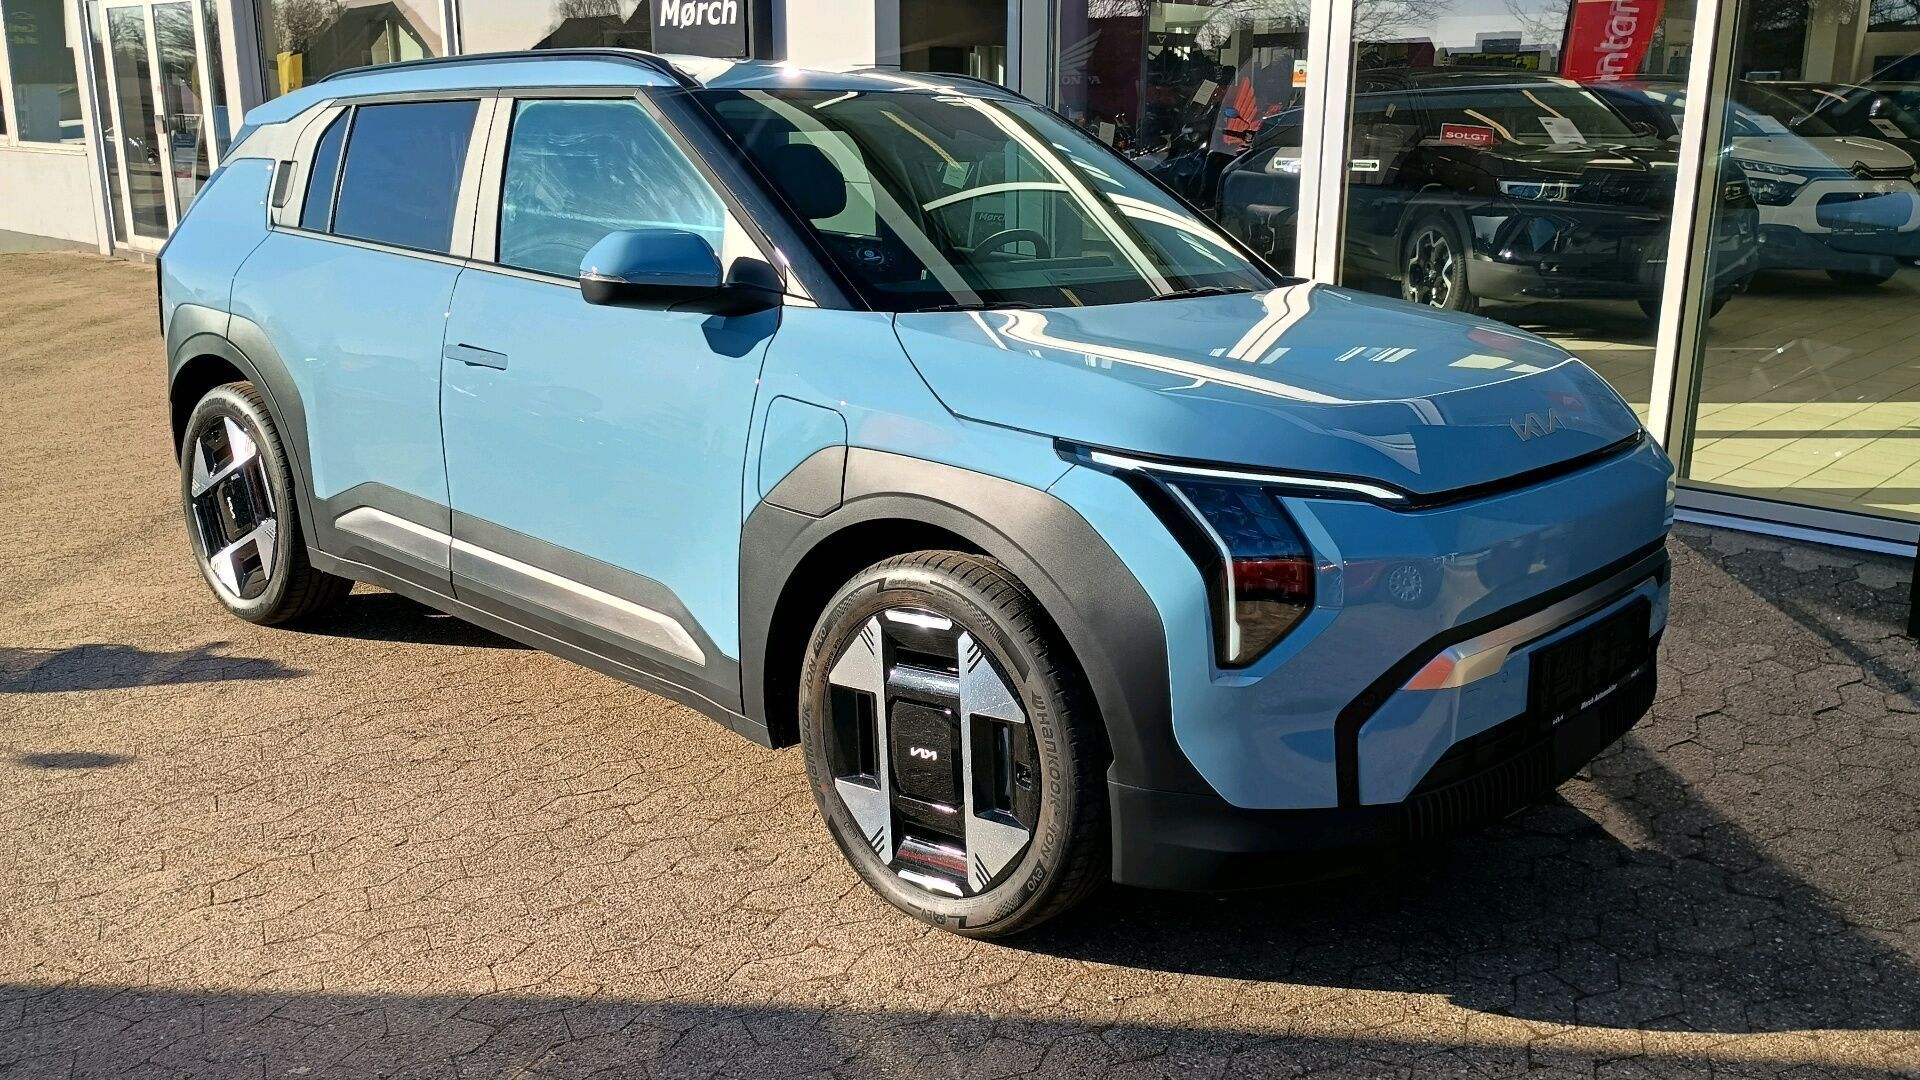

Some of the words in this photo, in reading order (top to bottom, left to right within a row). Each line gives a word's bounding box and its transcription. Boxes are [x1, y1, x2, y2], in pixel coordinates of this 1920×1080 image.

[660, 0, 738, 29] Mørch
[1445, 130, 1490, 142] SOLGT
[1027, 866, 1045, 893] evo
